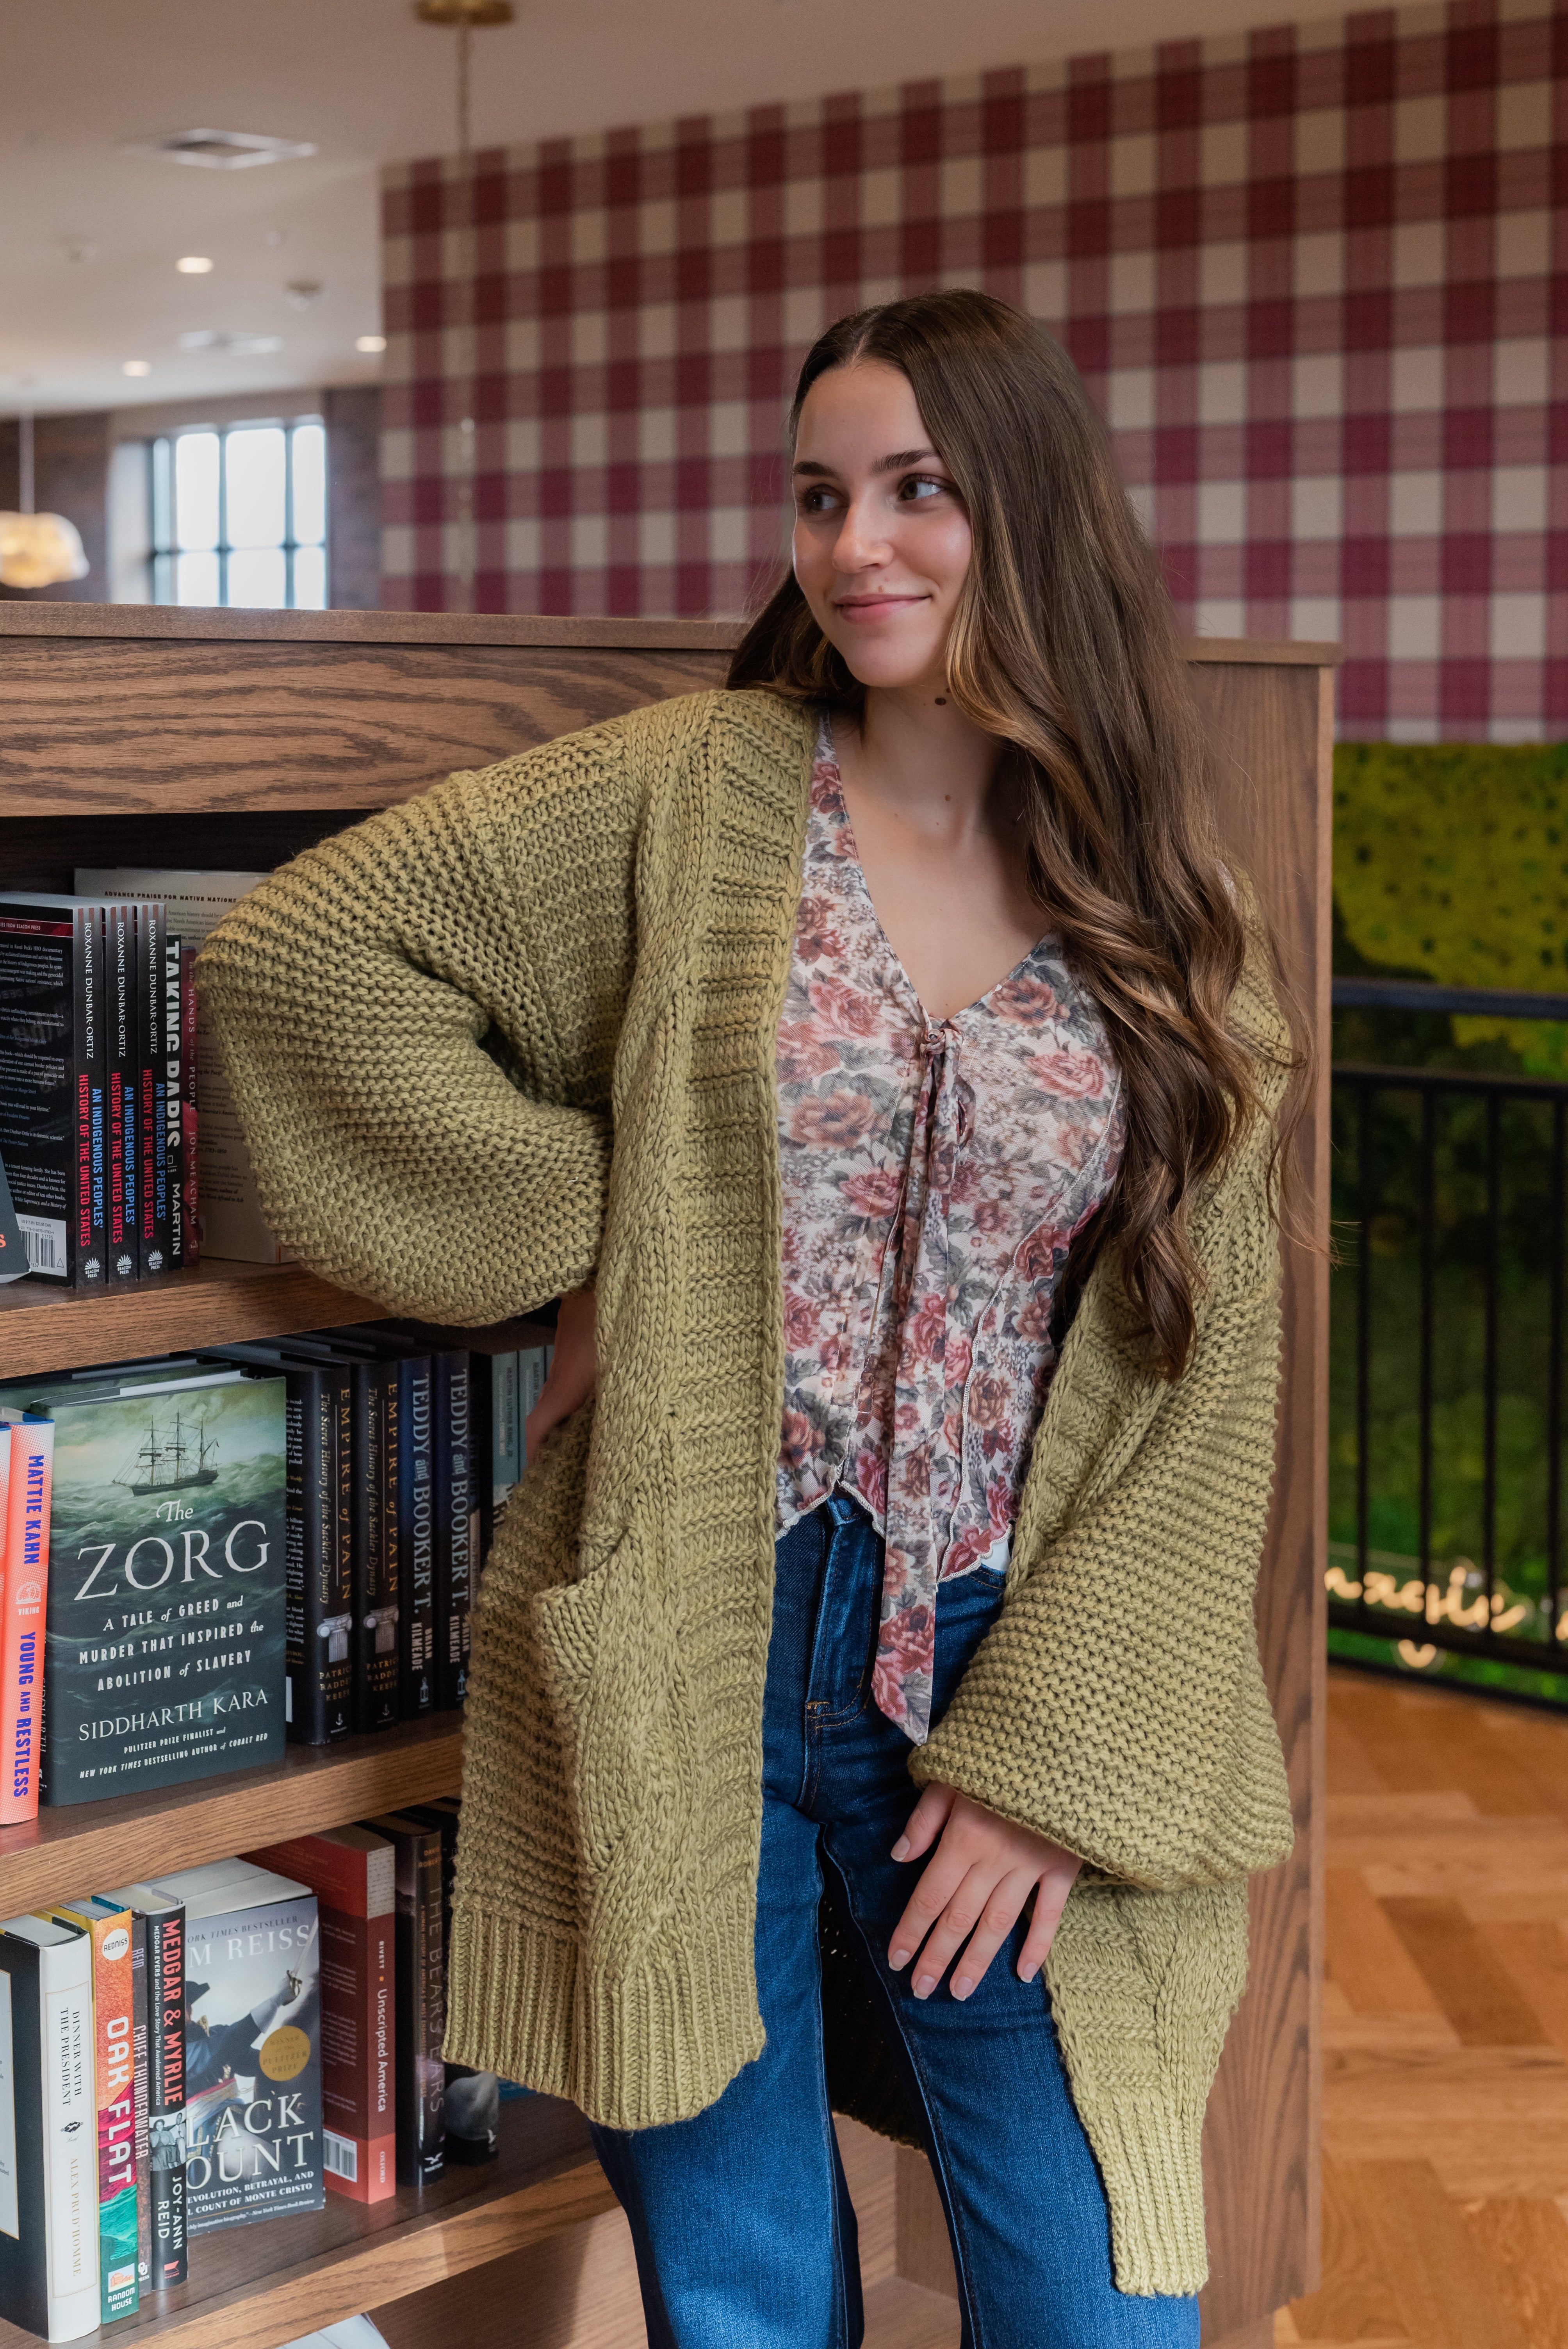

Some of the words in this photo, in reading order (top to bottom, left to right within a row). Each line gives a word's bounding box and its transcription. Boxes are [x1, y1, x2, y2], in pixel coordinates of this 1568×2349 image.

[79, 1075, 89, 1120] HISTORY
[92, 1089, 102, 1103] AN
[111, 1073, 121, 1118] HISTORY
[125, 1087, 134, 1101] AN
[143, 1069, 152, 1114] HISTORY
[156, 1083, 165, 1097] AN
[80, 1124, 89, 1137] OF
[93, 1106, 103, 1174] INDIGENOUS
[112, 1122, 121, 1135] OF
[125, 1104, 134, 1171] INDIGENOUS
[143, 1118, 152, 1132] OF
[156, 1101, 166, 1167] INDIGENOUS
[80, 1141, 89, 1162] THE
[112, 1139, 121, 1160] THE
[144, 1135, 153, 1156] THE
[80, 1166, 90, 1205] UNITED
[112, 1163, 122, 1202] UNITED
[144, 1159, 153, 1198] UNITED
[80, 1208, 90, 1247] STATES
[112, 1205, 122, 1244] STATES
[144, 1201, 153, 1239] STATES
[172, 1183, 180, 1255] MARTIN
[321, 1393, 330, 1412] The
[413, 1372, 429, 1453] TEDDY
[451, 1368, 467, 1448] TEDDY
[321, 1416, 330, 1446] Secret
[341, 1388, 350, 1495] EMPIRE
[26, 1455, 44, 1513] MATTIE
[319, 1449, 330, 1486] History
[415, 1459, 429, 1481] and
[452, 1454, 467, 1476] and
[157, 1499, 193, 1522] The
[319, 1491, 331, 1502] of
[322, 1504, 331, 1520] the
[339, 1508, 350, 1522] of
[24, 1520, 41, 1564] KAHN
[322, 1524, 331, 1560] Sackler
[413, 1486, 431, 1589] BOOKER
[451, 1480, 469, 1582] BOOKER
[74, 1520, 271, 1600] ZORG
[342, 1534, 351, 1599] PAIN
[319, 1564, 331, 1604] Dynasty
[414, 1592, 431, 1614] T.
[452, 1585, 469, 1607] T.
[18, 1606, 39, 1615] VIKING
[103, 1618, 114, 1631] A
[122, 1611, 153, 1627] TALE
[161, 1608, 172, 1622] of
[179, 1599, 219, 1617] GREED
[227, 1595, 244, 1609] and
[19, 1631, 36, 1685] YOUNG
[79, 1643, 134, 1664] MURDER
[142, 1636, 173, 1653] THAT
[182, 1623, 243, 1645] INSPIRED
[250, 1621, 264, 1633] the
[412, 1622, 423, 1671] KILMEADE
[450, 1616, 460, 1663] KILMEADE
[98, 1666, 171, 1691] ABOLITION
[179, 1663, 191, 1677] of
[197, 1650, 251, 1672] SLAVERY
[20, 1691, 30, 1712] AND
[79, 1701, 202, 1741] SIDDHARTH
[213, 1689, 268, 1715] KARA
[14, 1717, 32, 1797] RESTLESS
[80, 1769, 96, 1779] NEW
[99, 1765, 118, 1775] YORK
[121, 1760, 141, 1771] TIMES
[144, 1750, 188, 1766] BESTSELLING
[192, 1744, 217, 1756] AUTHOR
[229, 1736, 253, 1747] COBALT
[256, 1733, 268, 1741] RED
[124, 1741, 157, 1754] PULITZER
[160, 1736, 180, 1747] PRIZE
[183, 1729, 214, 1741] FINALIST
[104, 1937, 128, 1952] REDNISS
[211, 1928, 238, 1938] TIMES
[242, 1916, 298, 1932] BESTSELLER
[227, 1925, 310, 1960] REISS
[163, 1919, 181, 2002] MEDGAR
[61, 2007, 69, 2033] THE
[73, 2011, 81, 2059] DINNER
[163, 2009, 181, 2027] &
[375, 1988, 389, 2058] Unscripted
[107, 2016, 129, 2087] OAK
[164, 2031, 182, 2106] MYRLIE
[61, 2037, 71, 2106] PRESIDENT
[378, 2061, 388, 2112] America
[186, 2093, 305, 2149] LACK
[108, 2099, 132, 2183] FLAT
[186, 2131, 314, 2190] OUNT
[70, 2158, 78, 2189] ALEX
[187, 2187, 242, 2204] EVOLUTION,
[244, 2176, 292, 2191] BETRAYAL,
[294, 2171, 314, 2181] AND
[172, 2177, 183, 2250] JOY-ANN
[195, 2200, 228, 2214] COUNT
[229, 2197, 242, 2205] OF
[244, 2190, 277, 2203] MONTE
[279, 2183, 313, 2195] CRISTO
[158, 2200, 170, 2239] REID
[108, 2287, 135, 2303] RANDOM
[111, 2297, 132, 2311] HOUSE
